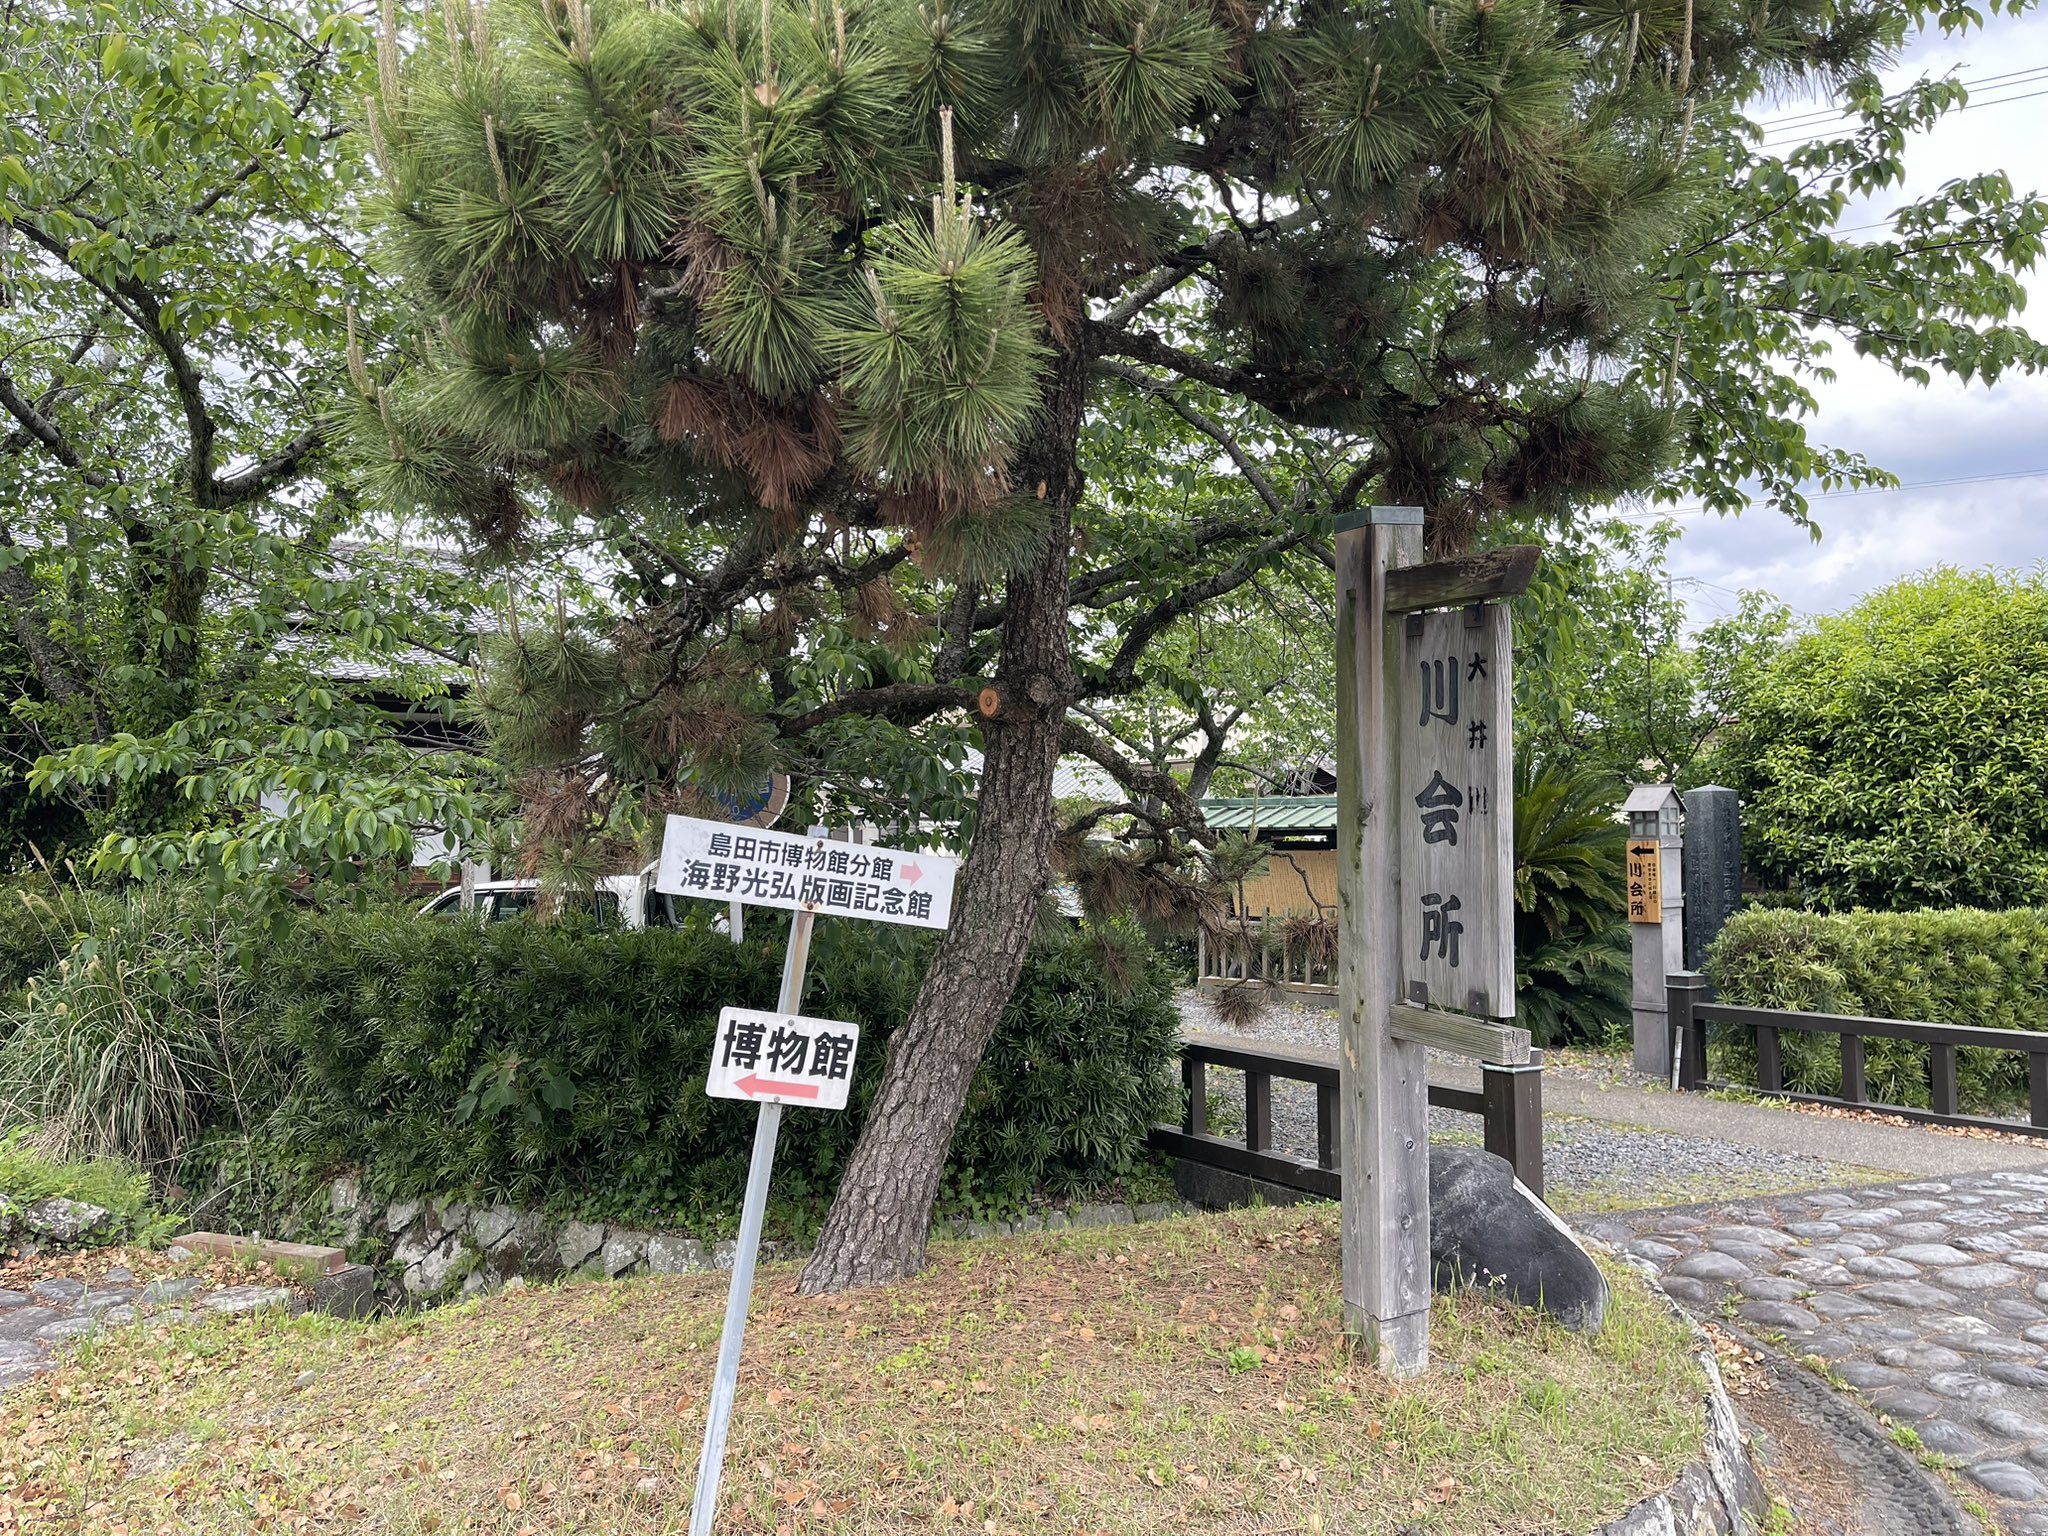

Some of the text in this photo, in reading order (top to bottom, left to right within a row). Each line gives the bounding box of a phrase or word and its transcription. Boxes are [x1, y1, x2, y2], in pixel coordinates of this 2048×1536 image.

[1467, 652, 1488, 815] 大井川
[1414, 656, 1464, 968] 川会所
[708, 832, 893, 881] 島田市博物館分館
[680, 859, 933, 920] 海野光弘版画記念館
[1629, 862, 1643, 916] 川会所
[722, 1020, 854, 1080] 博物館
